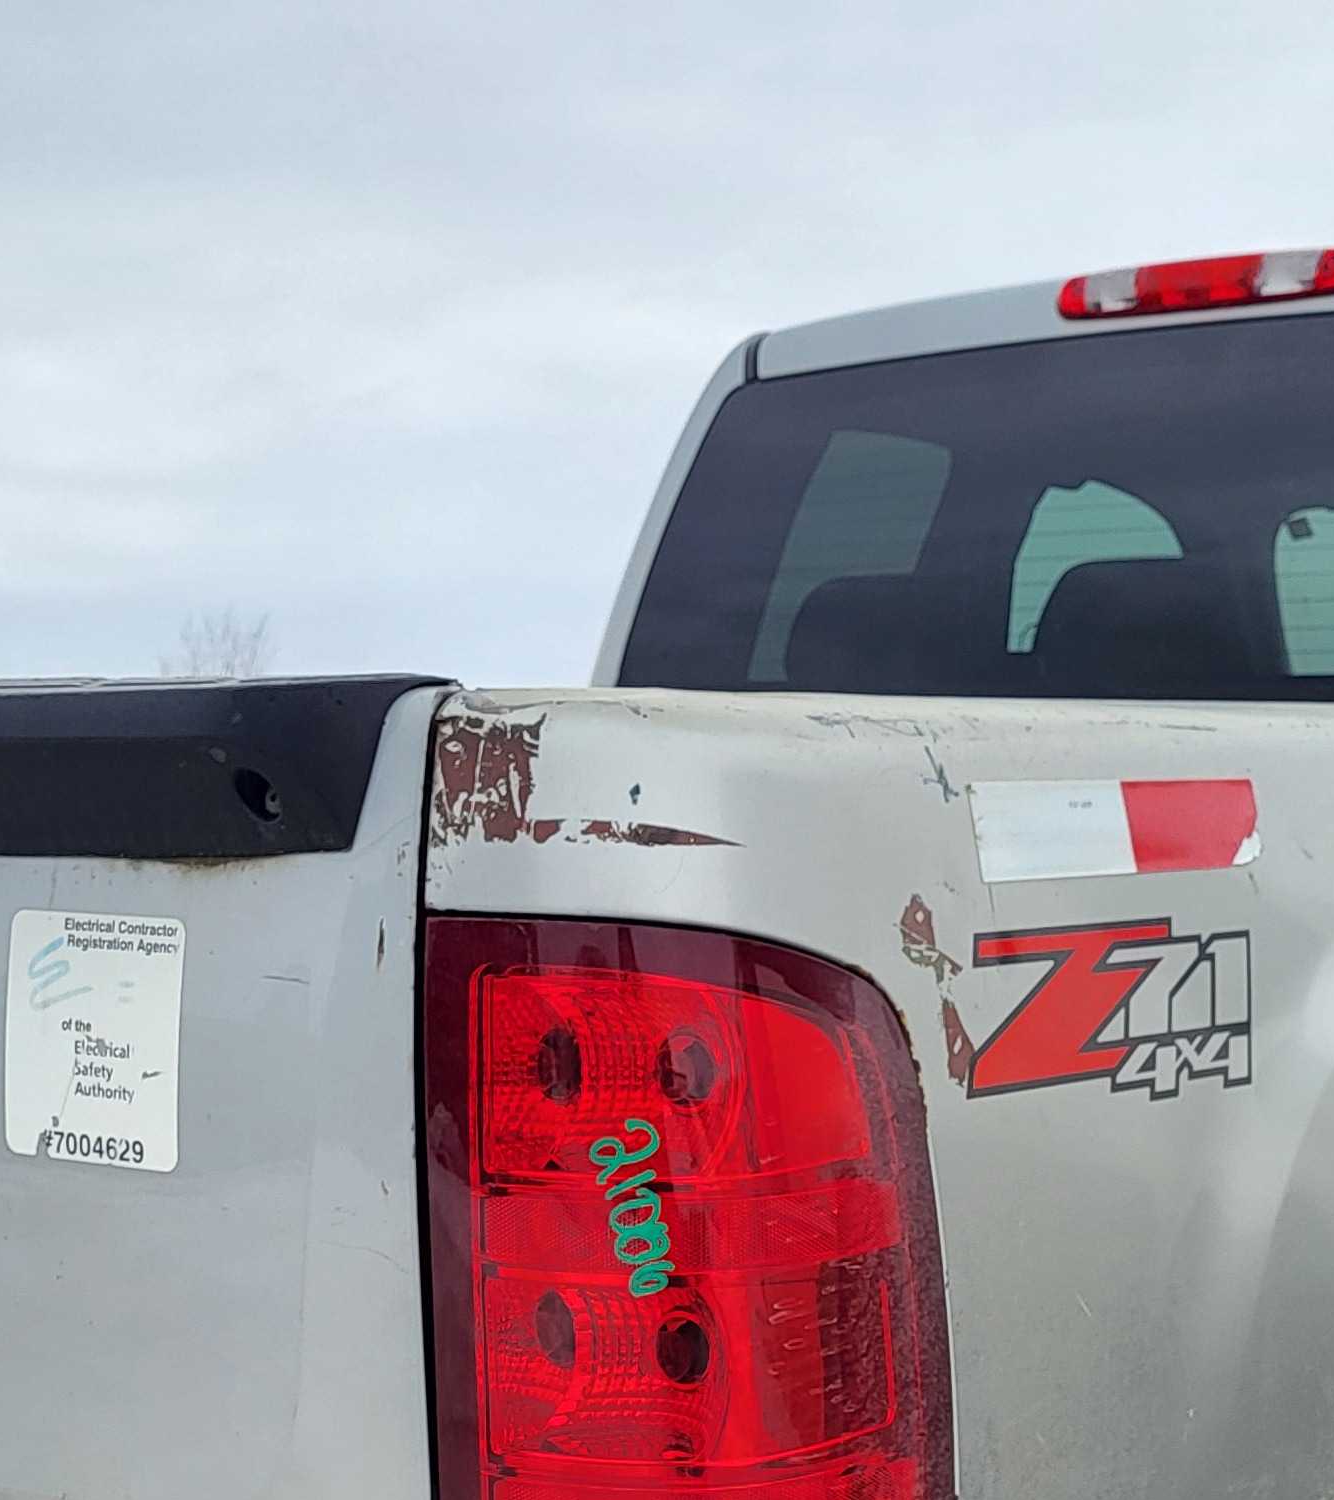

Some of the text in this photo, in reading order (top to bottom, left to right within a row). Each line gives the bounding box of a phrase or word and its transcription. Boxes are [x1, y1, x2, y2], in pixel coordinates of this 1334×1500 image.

[64, 917, 179, 938] Electrical Contractor
[67, 934, 180, 956] Registration Agency
[966, 916, 1251, 1099] Z71
[61, 1018, 92, 1032] of the
[74, 1057, 114, 1082] Safety
[74, 1082, 135, 1104] Authority
[43, 1129, 144, 1163] #7004629
